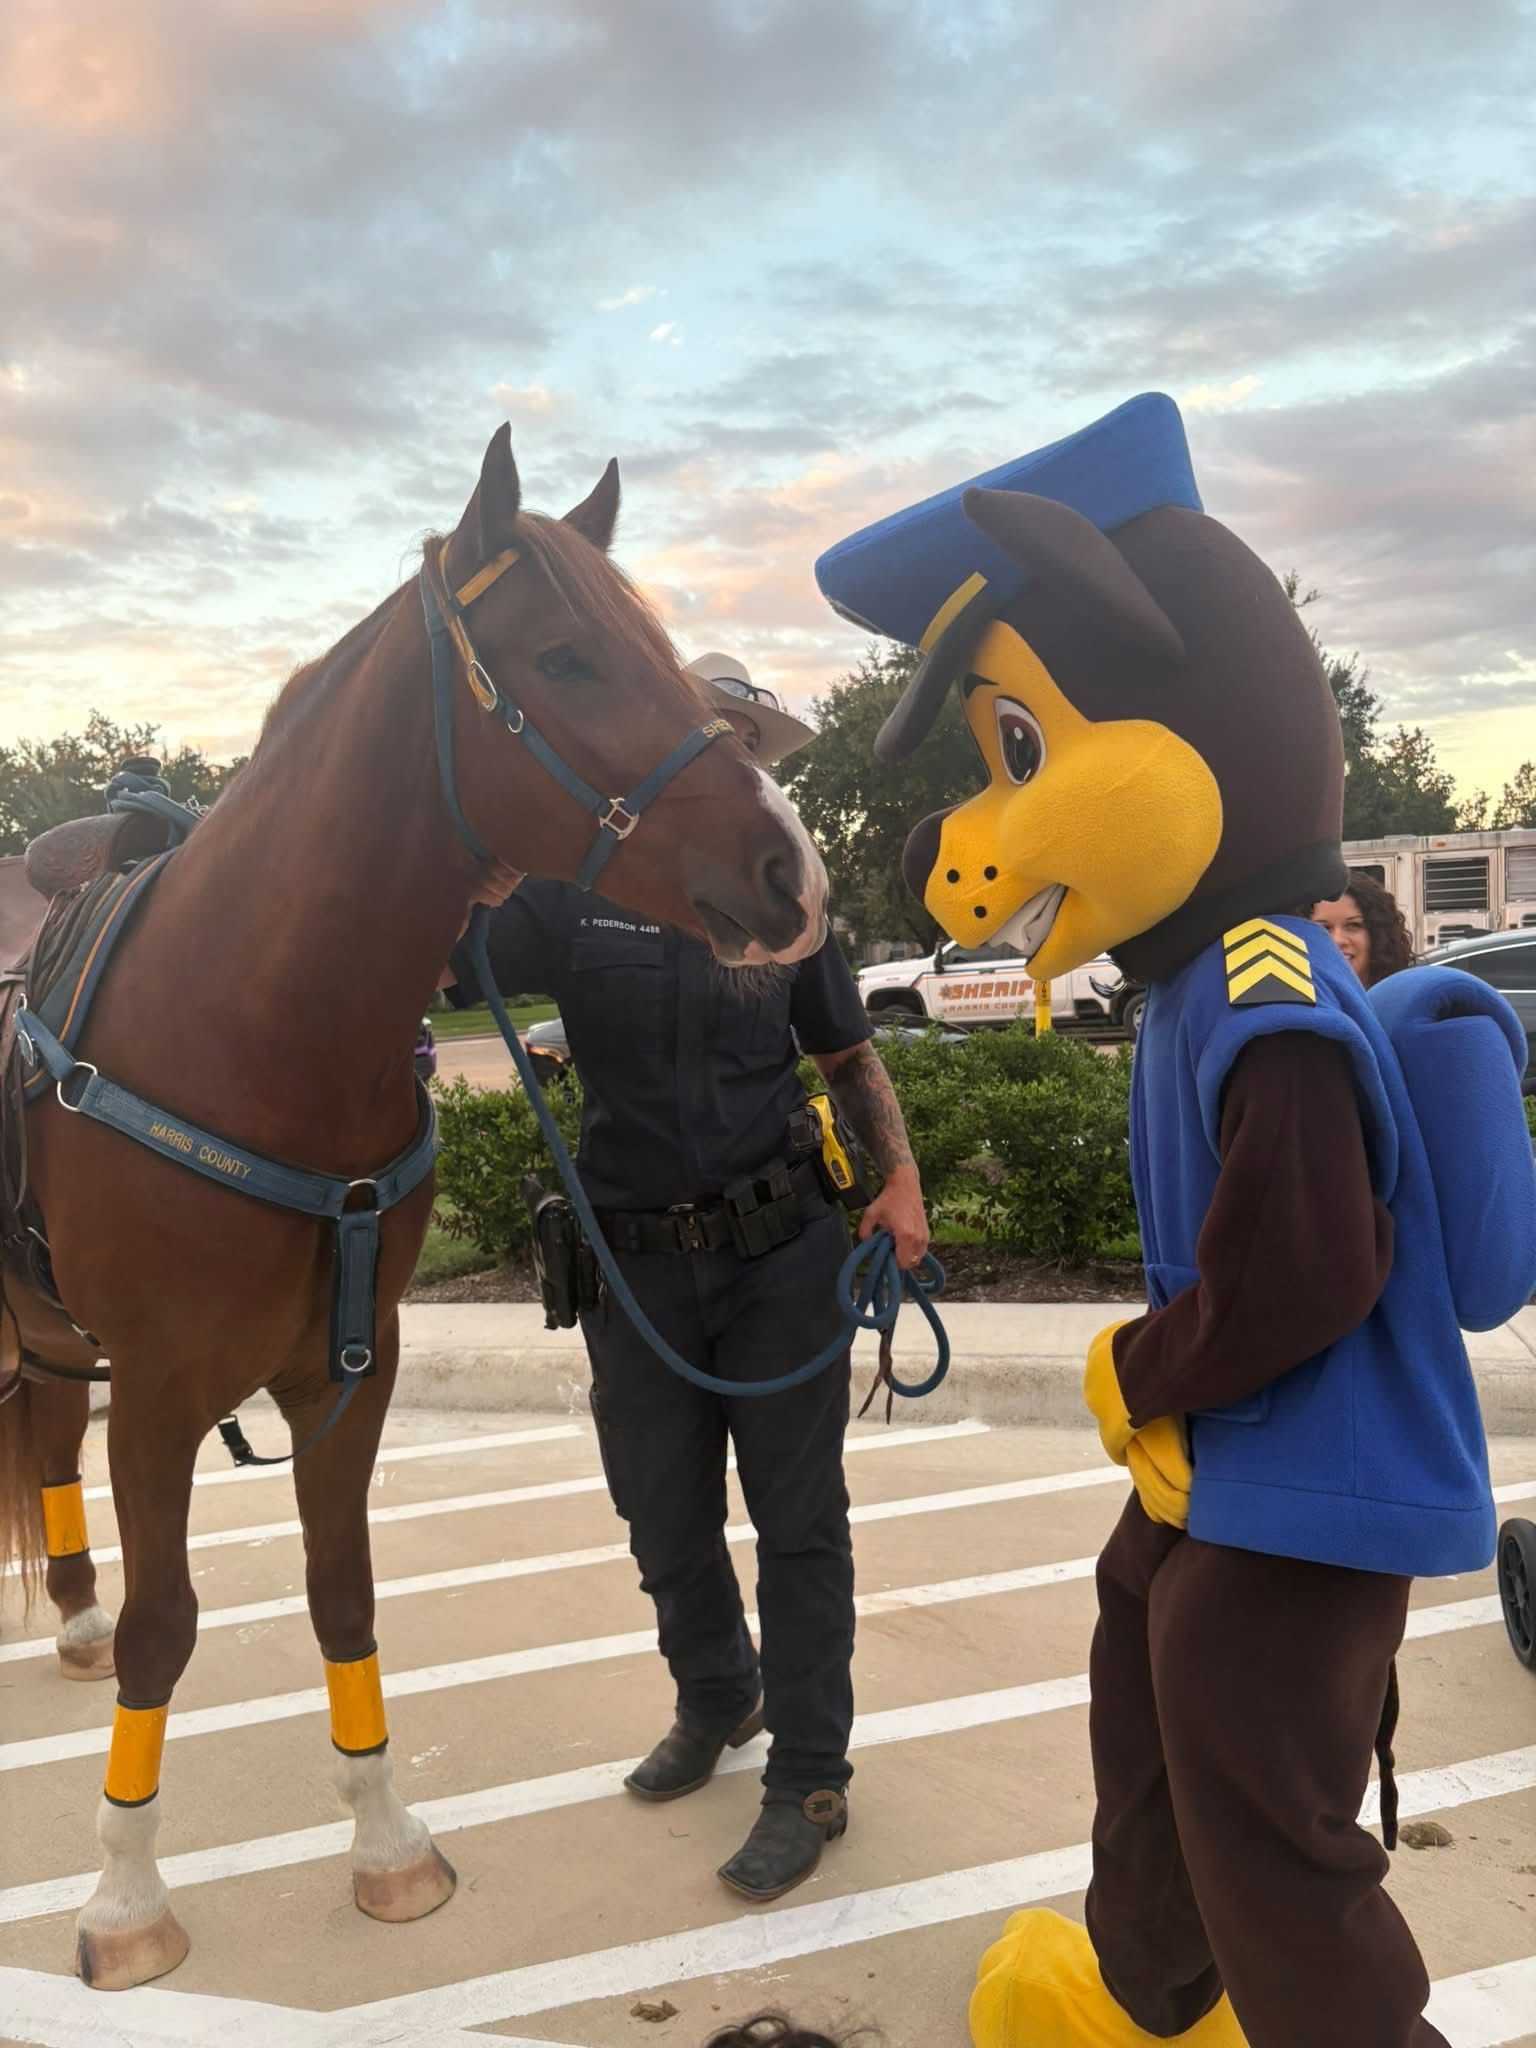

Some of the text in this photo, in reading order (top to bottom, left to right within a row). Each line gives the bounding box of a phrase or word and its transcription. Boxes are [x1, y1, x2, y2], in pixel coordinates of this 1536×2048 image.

[592, 918, 636, 931] PEDERSON
[951, 980, 1036, 1000] SHERIF
[149, 1121, 251, 1179] HARRIS COUNTY
